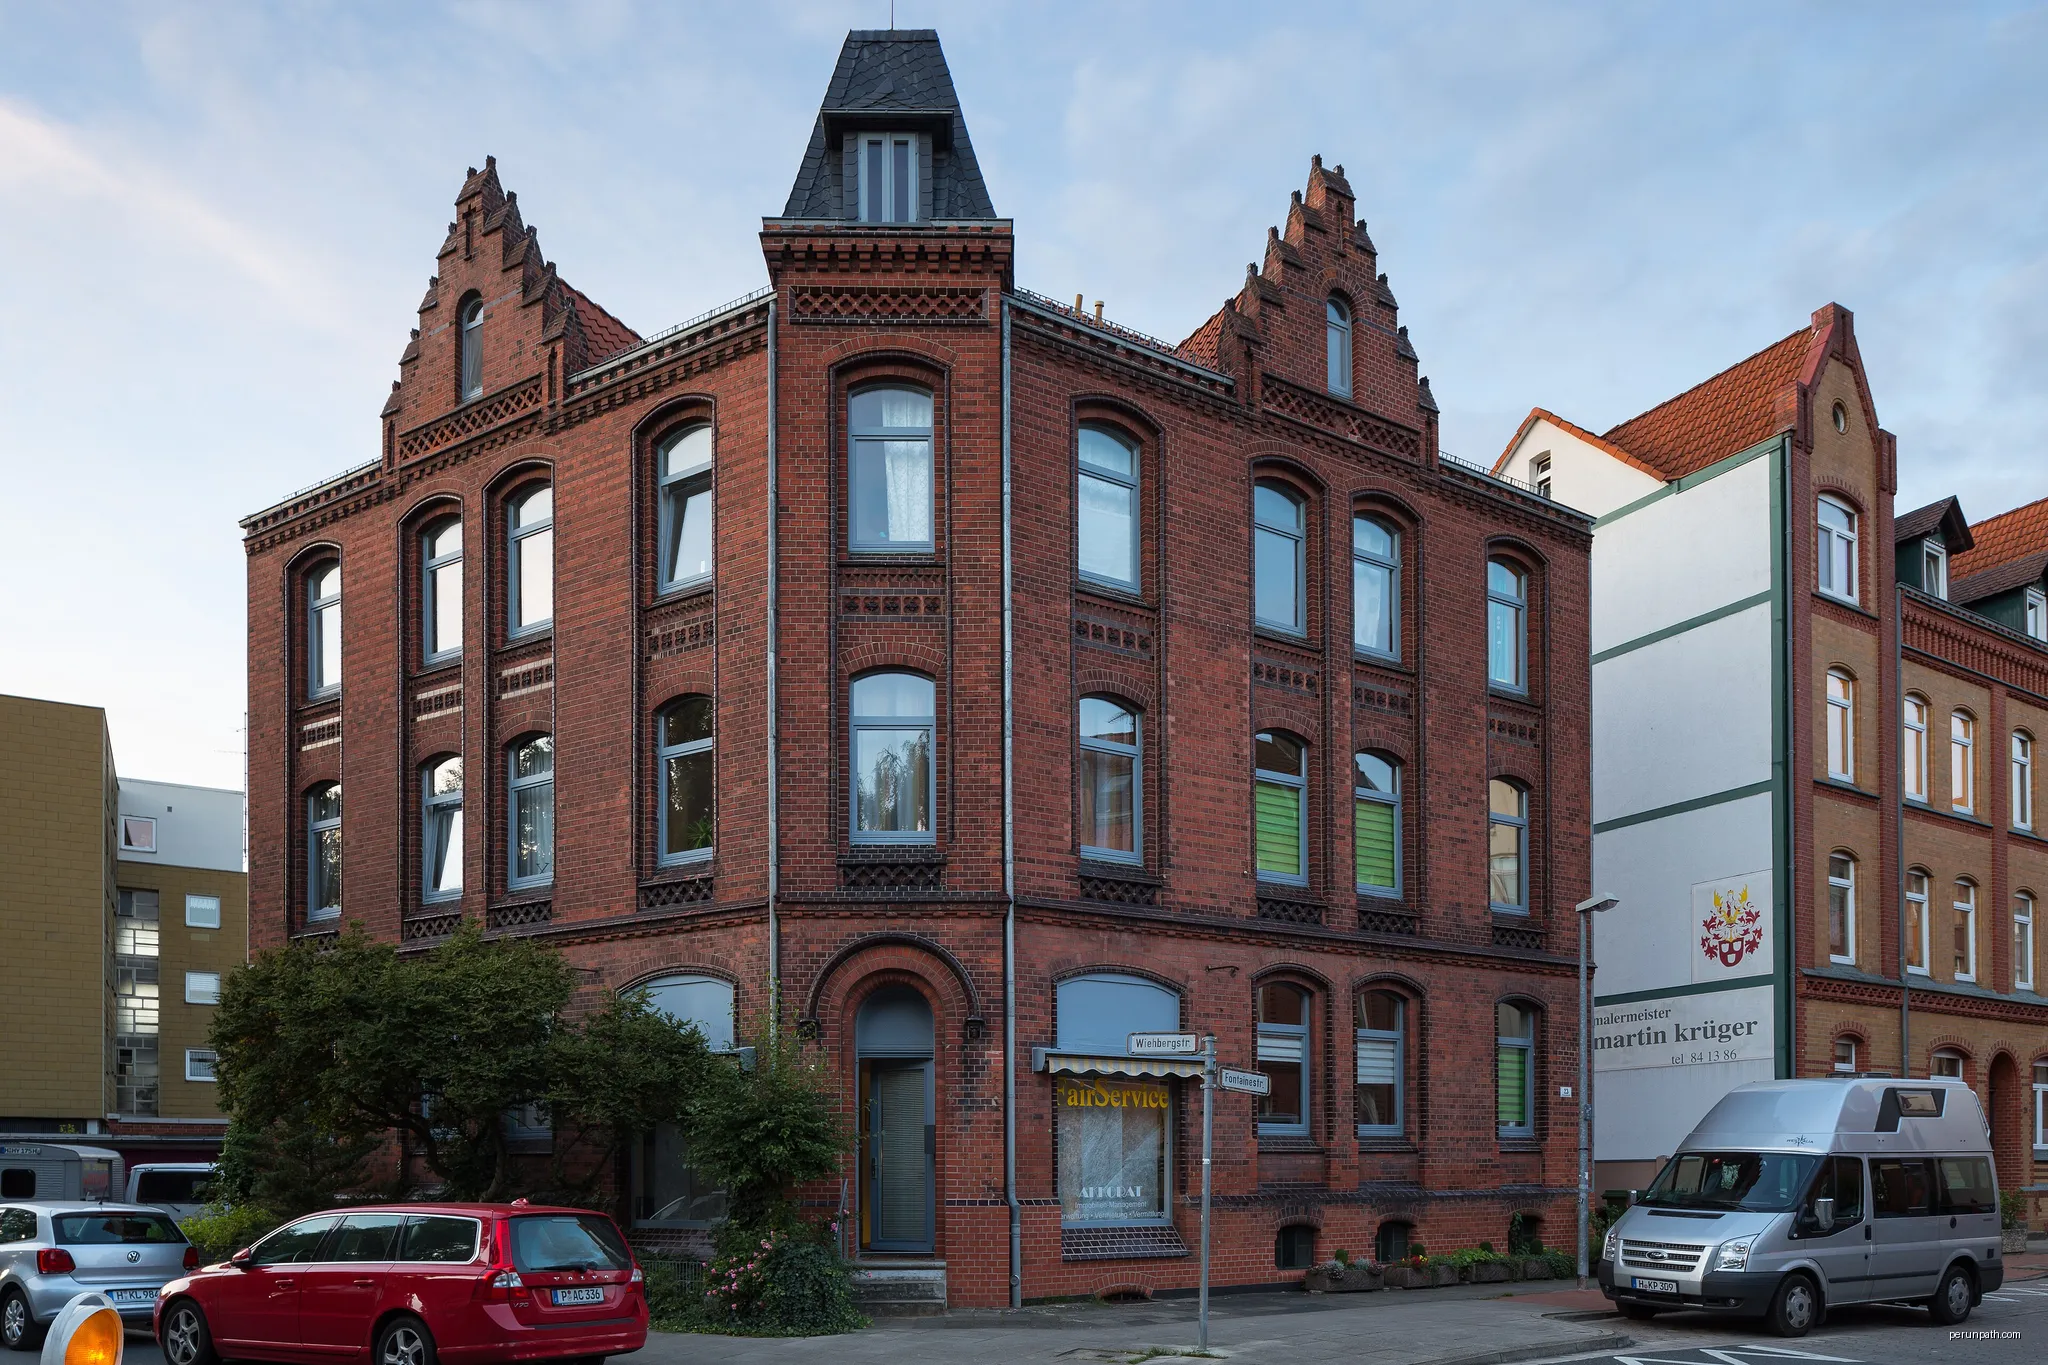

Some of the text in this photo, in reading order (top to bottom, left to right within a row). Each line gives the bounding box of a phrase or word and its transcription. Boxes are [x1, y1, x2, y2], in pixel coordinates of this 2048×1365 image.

[1594, 1008, 1671, 1026] malermeister
[1594, 1020, 1758, 1050] martin krüger
[1136, 1038, 1191, 1050] Wiehbergstr.
[1671, 1049, 1737, 1065] tel 84 13 86
[1225, 1072, 1265, 1089] Fontainestr.
[116, 1291, 124, 1300] H
[129, 1290, 142, 1299] KL
[561, 1289, 600, 1301] P AC 336
